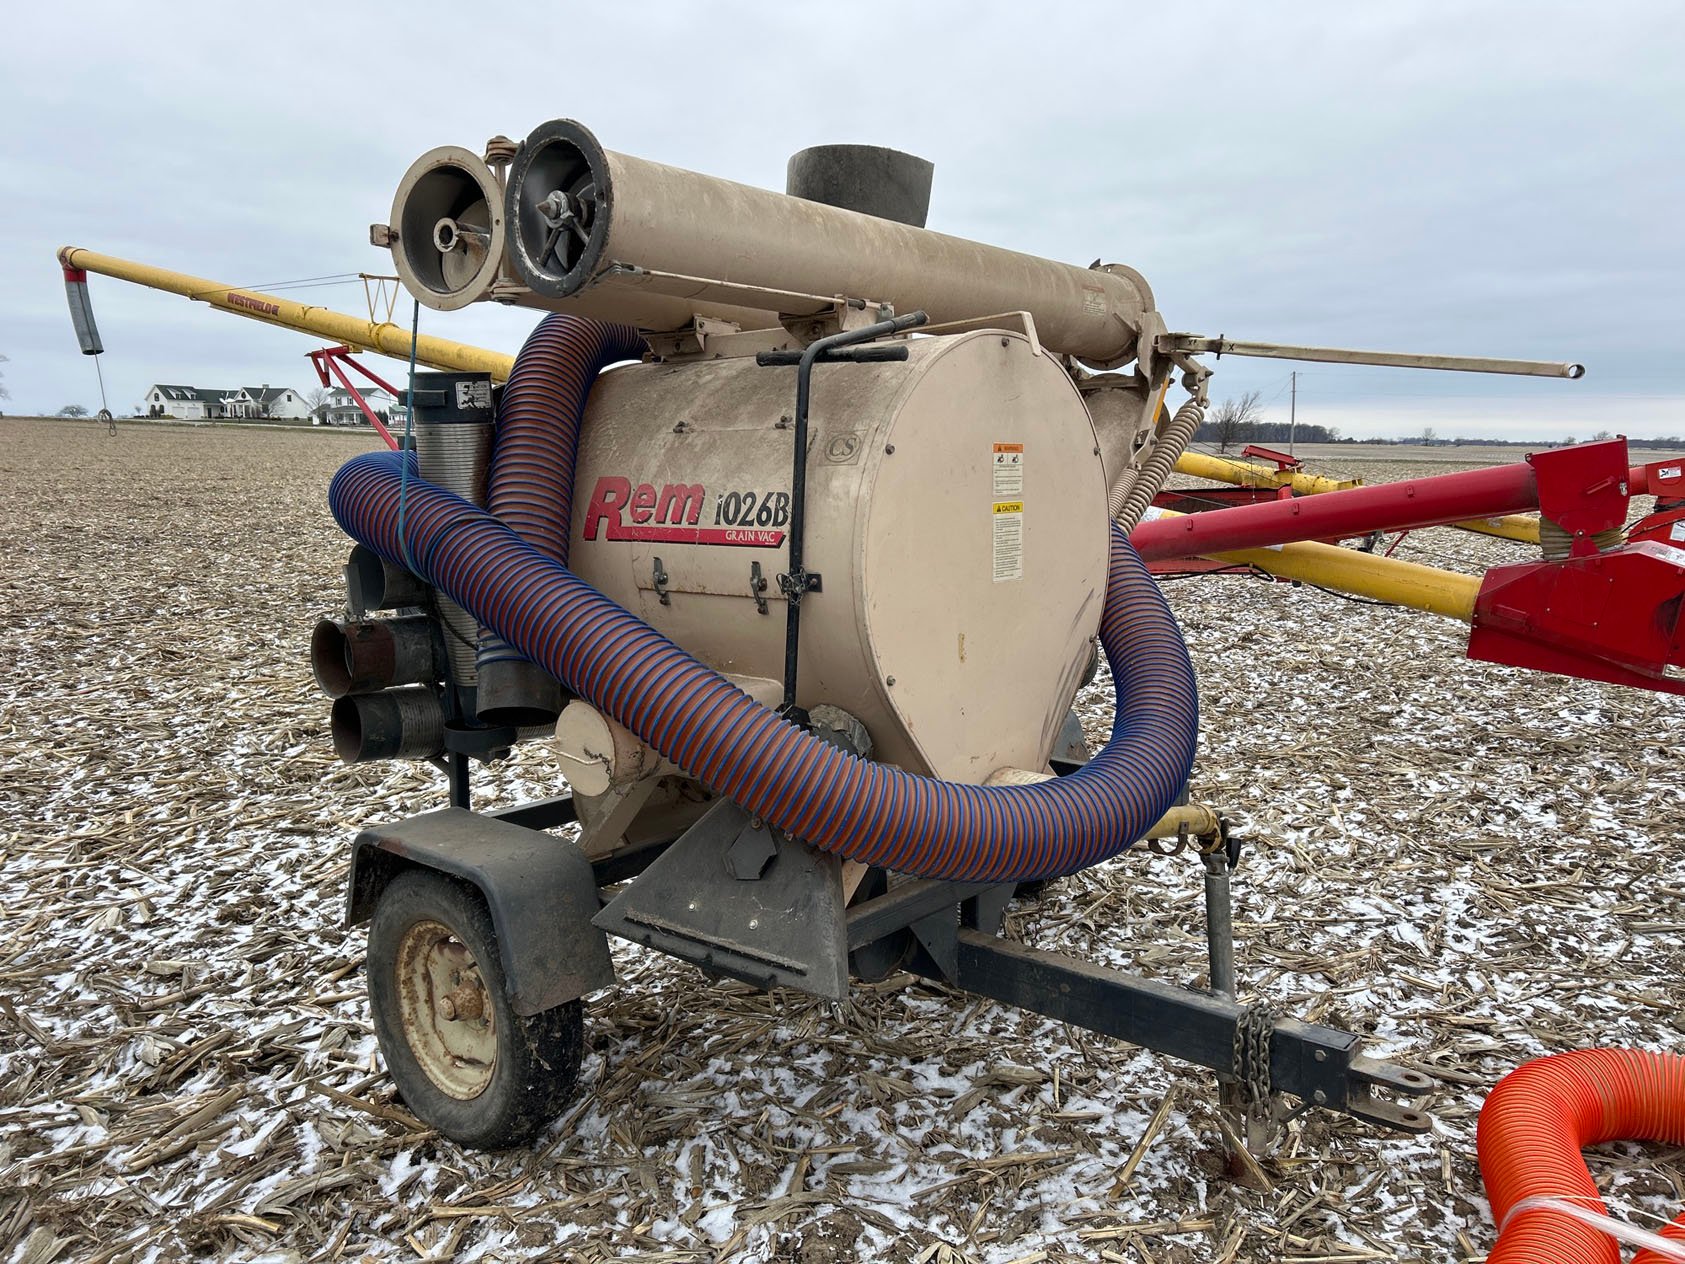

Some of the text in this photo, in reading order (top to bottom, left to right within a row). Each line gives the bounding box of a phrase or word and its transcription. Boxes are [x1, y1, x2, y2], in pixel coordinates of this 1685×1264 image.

[583, 476, 706, 542] Rem
[1002, 504, 1021, 512] CAUTION
[725, 530, 776, 542] GRAIN VAC
